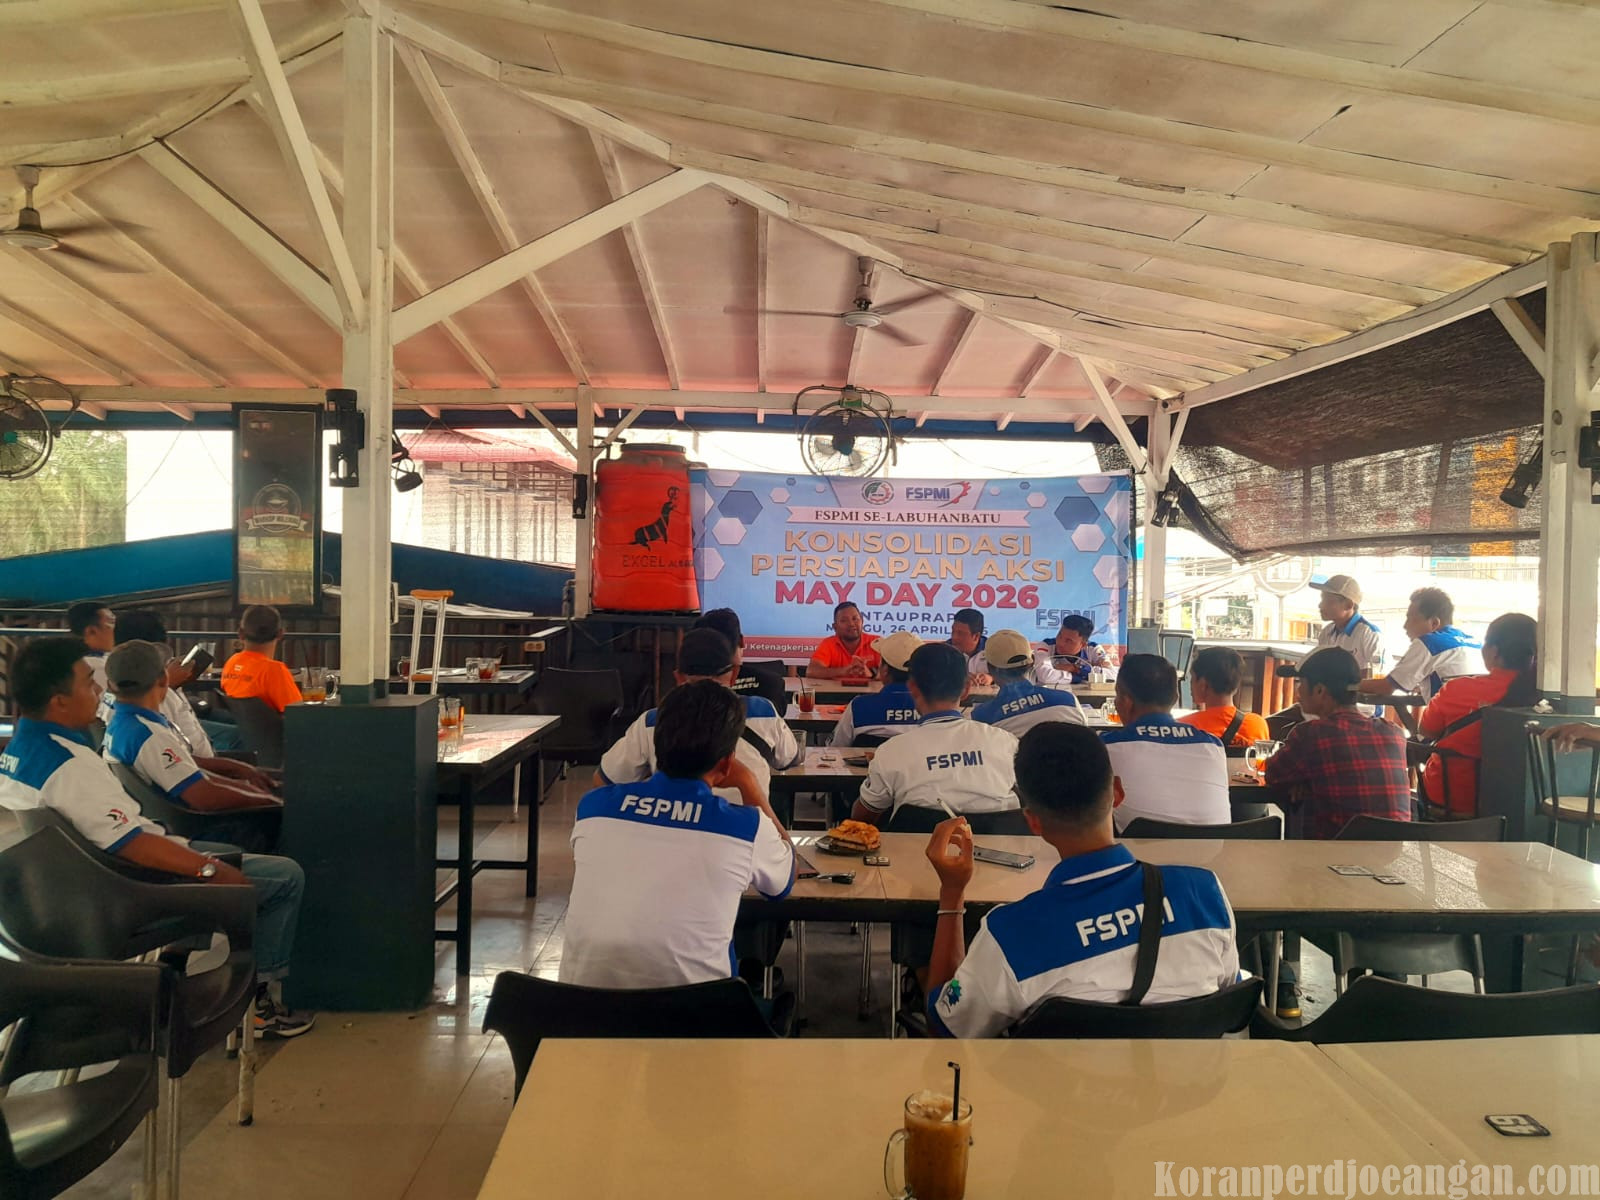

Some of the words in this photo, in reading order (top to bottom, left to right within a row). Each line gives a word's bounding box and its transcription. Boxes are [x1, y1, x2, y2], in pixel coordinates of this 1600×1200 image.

[905, 487, 950, 500] FSPMI
[814, 510, 859, 522] FSPMI
[863, 511, 1001, 524] SE-LABUHANBATU
[784, 530, 1032, 557] KONSOLIDASI
[622, 554, 665, 568] EXCEL
[751, 554, 963, 579] PERSIAPAN
[977, 559, 1065, 582] AKSI
[775, 580, 856, 606] MAY
[866, 581, 942, 607] DAY
[951, 583, 1040, 609] 2026
[910, 624, 951, 635] APRIL
[886, 708, 921, 721] FSPM
[1001, 693, 1045, 715] FSPMI
[1135, 725, 1194, 738] FSPMI
[926, 750, 984, 771] FSPMI
[619, 794, 703, 824] FSPMI
[1075, 896, 1175, 948] FSPI
